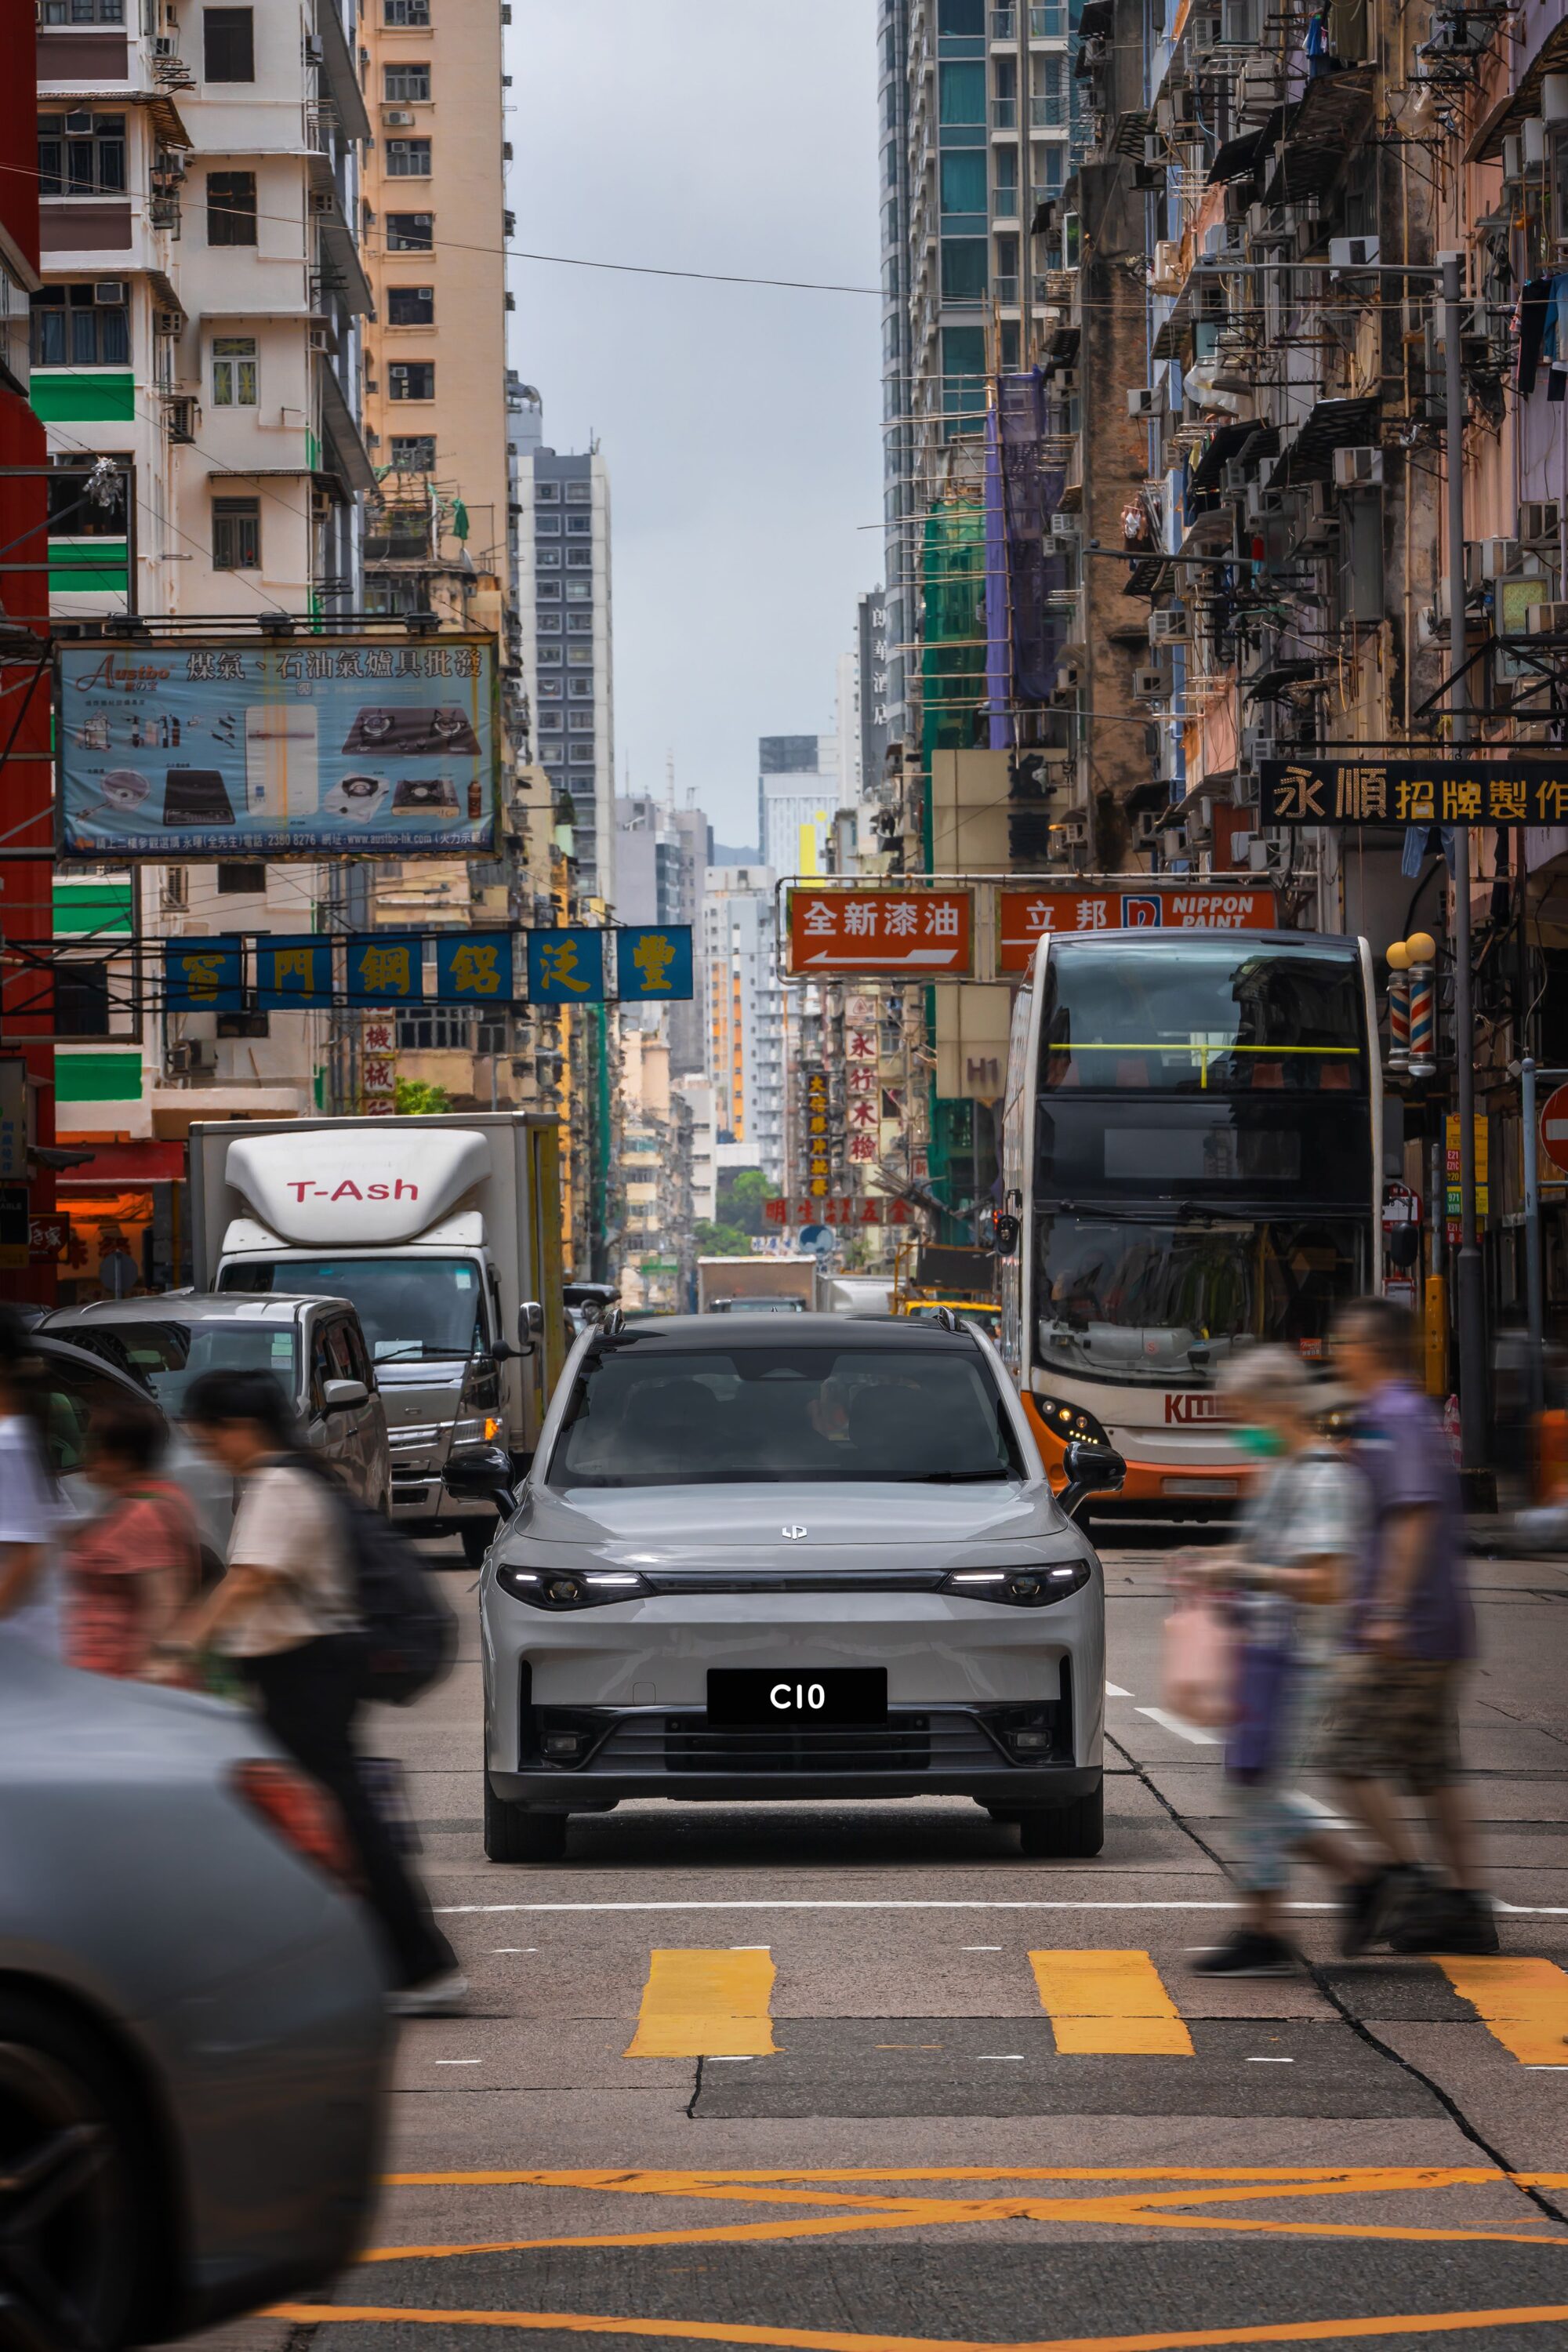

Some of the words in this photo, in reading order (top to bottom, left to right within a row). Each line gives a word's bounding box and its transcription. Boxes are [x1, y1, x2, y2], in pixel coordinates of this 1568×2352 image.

[75, 654, 170, 691] Austbo
[1025, 899, 1107, 930] 立邦
[1172, 896, 1253, 913] NIPPON
[804, 902, 959, 937] 全新漆油
[1182, 915, 1245, 928] PAINT
[287, 1178, 418, 1202] T-Ash
[770, 1683, 826, 1709] C10
